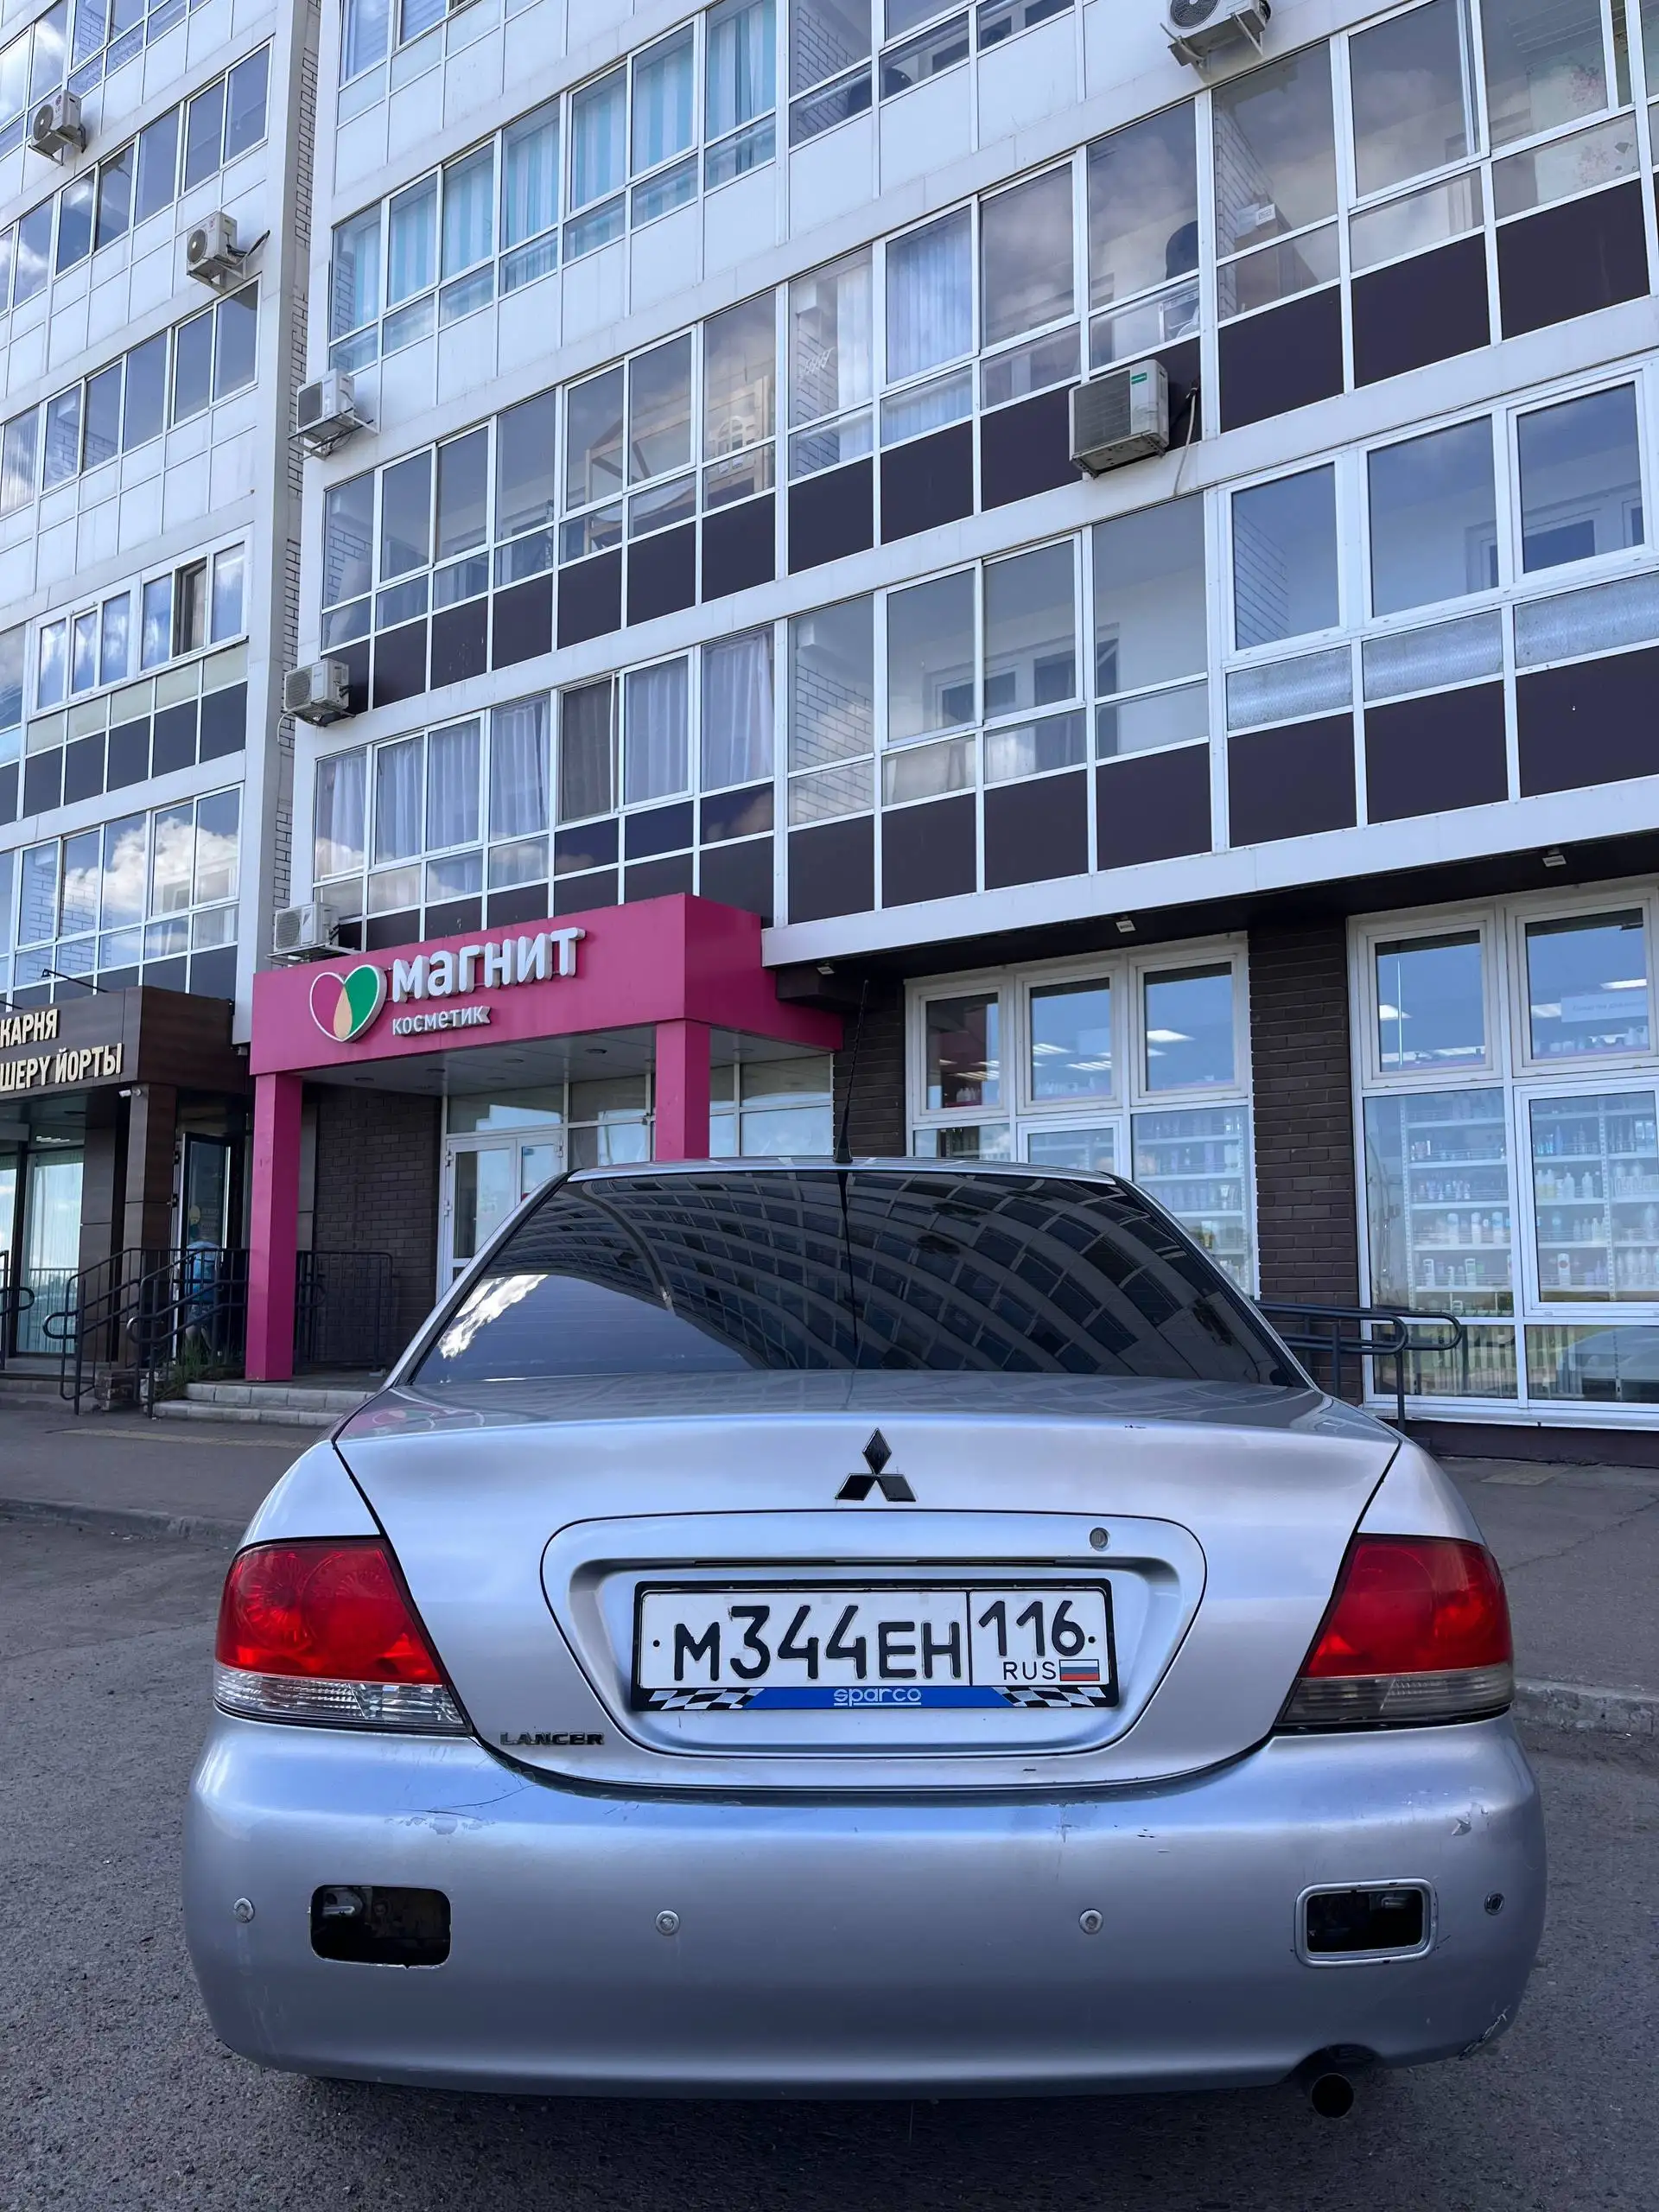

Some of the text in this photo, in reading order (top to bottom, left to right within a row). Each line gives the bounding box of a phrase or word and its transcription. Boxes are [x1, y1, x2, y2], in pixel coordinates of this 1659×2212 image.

[393, 1006, 490, 1035] косметик
[55, 1043, 122, 1084] ЙОРТЫ
[978, 1599, 1085, 1656] 116
[1003, 1660, 1057, 1681] RUS
[833, 1688, 922, 1707] sparco
[500, 1732, 604, 1745] LANCER
